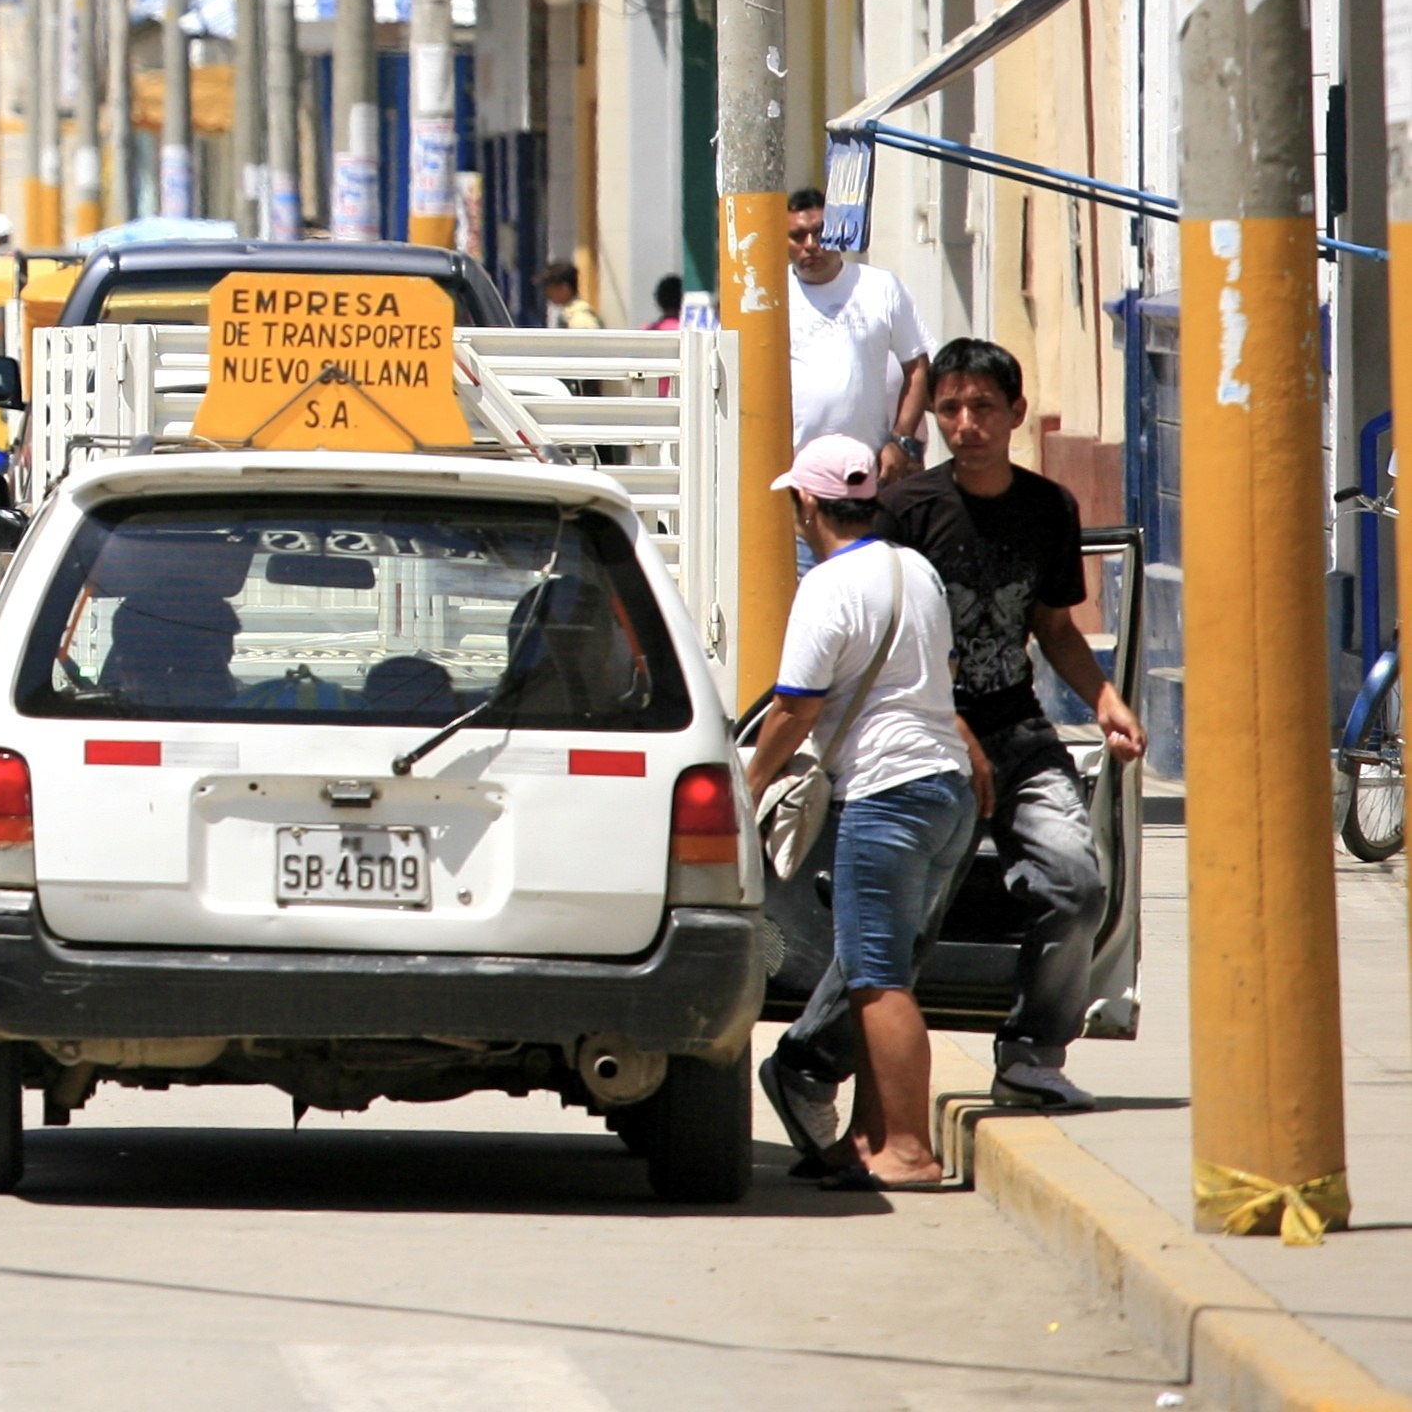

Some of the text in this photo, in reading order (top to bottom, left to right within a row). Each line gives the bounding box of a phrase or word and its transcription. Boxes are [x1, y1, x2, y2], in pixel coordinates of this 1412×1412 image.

[231, 289, 401, 318] EMPRESA
[222, 321, 442, 351] DE TRANSPORTES
[222, 356, 429, 388] NUEVO SULLANA
[283, 853, 420, 892] SB-4609
